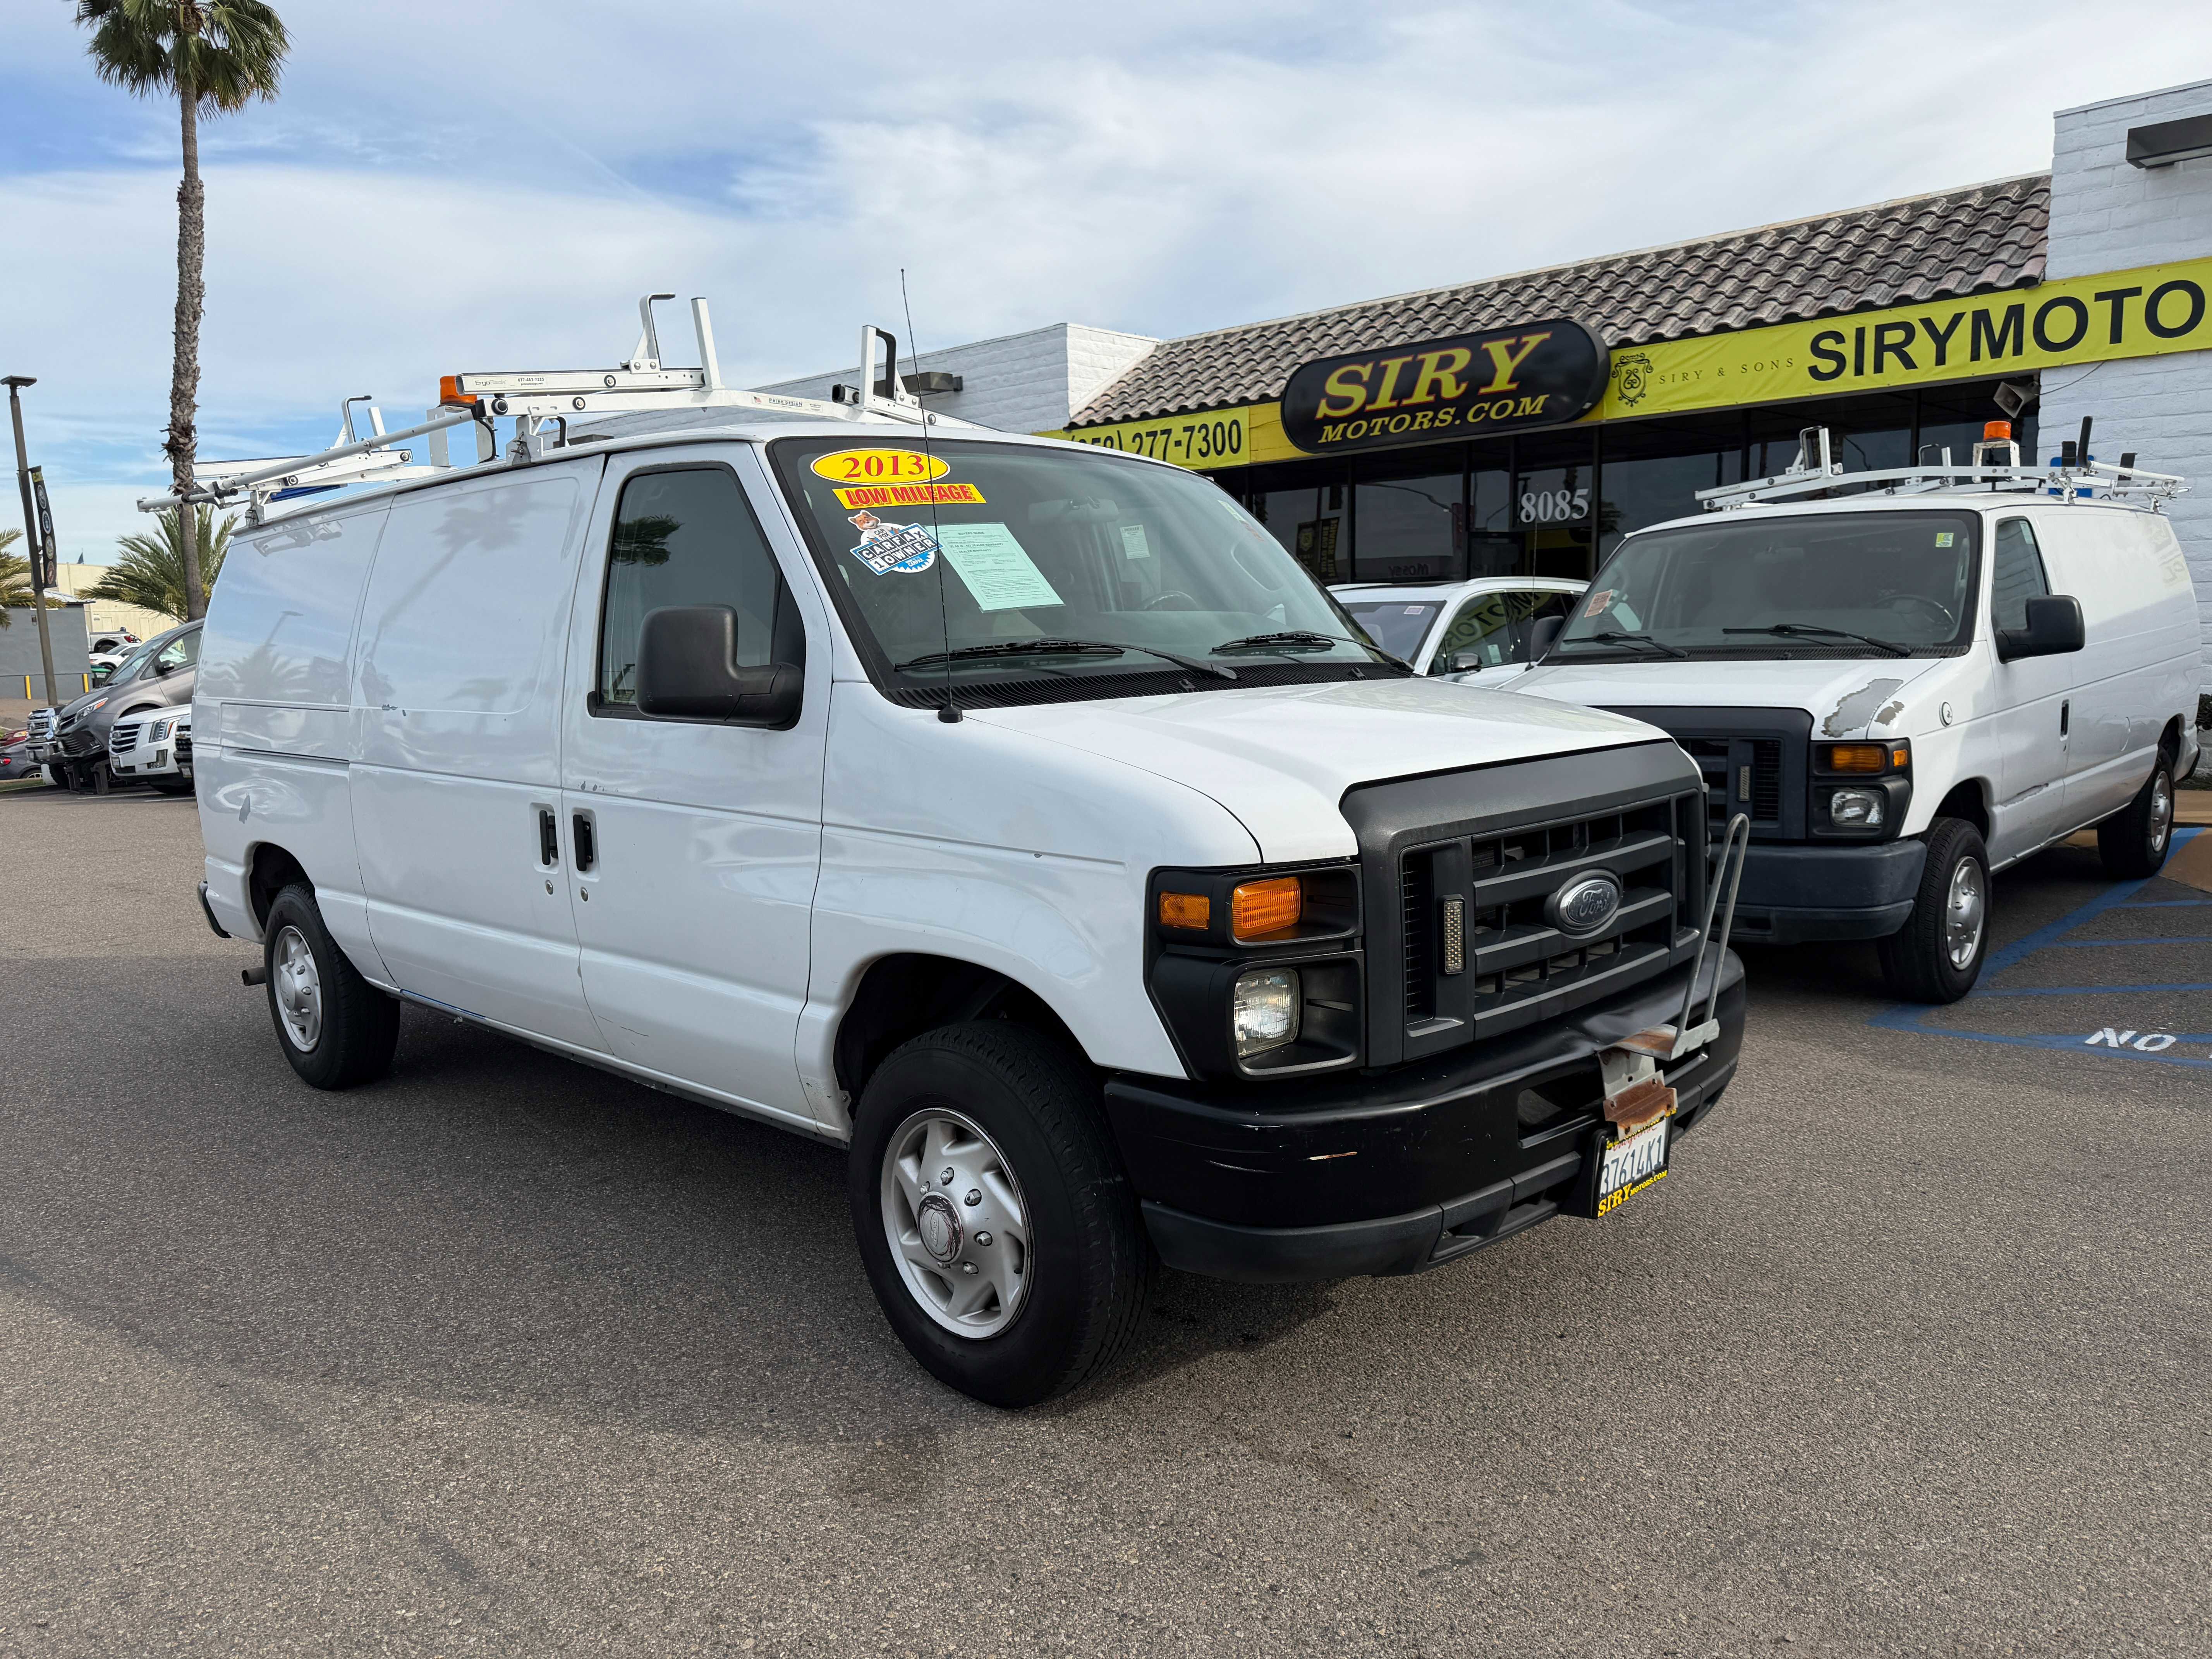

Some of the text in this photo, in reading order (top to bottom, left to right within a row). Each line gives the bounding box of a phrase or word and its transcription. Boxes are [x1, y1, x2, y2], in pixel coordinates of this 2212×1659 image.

[1807, 280, 2206, 381] SIRYMOTO
[1315, 331, 1552, 419] SIRY
[1659, 358, 1794, 384] SIRY & SONS
[1318, 394, 1550, 443] MOTORS.COM
[1132, 419, 1242, 462] 277-7300
[842, 455, 924, 478] 2013
[845, 485, 976, 507] LOW MILEAGE
[1520, 488, 1589, 523] 8085
[862, 530, 926, 559] CARFAX
[1579, 888, 1611, 917] Ford
[2085, 1027, 2177, 1052] NO
[1598, 1182, 1632, 1217] SIRY
